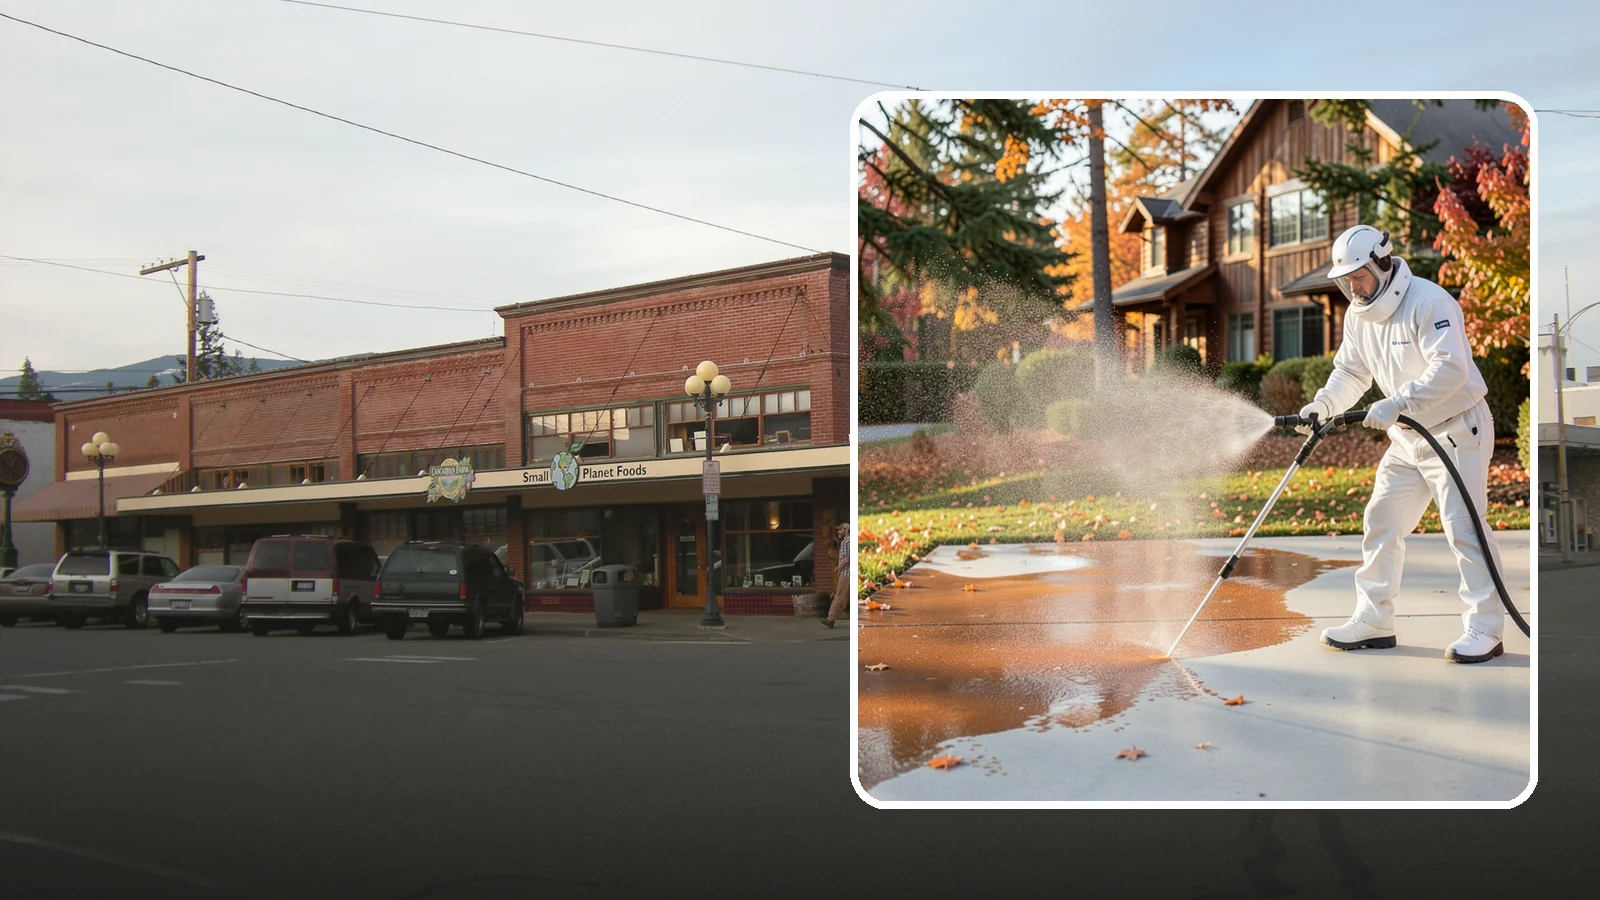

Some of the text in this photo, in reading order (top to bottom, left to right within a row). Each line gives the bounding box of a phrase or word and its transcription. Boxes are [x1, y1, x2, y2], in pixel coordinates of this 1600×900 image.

[523, 464, 647, 483] Small Planet Foods
